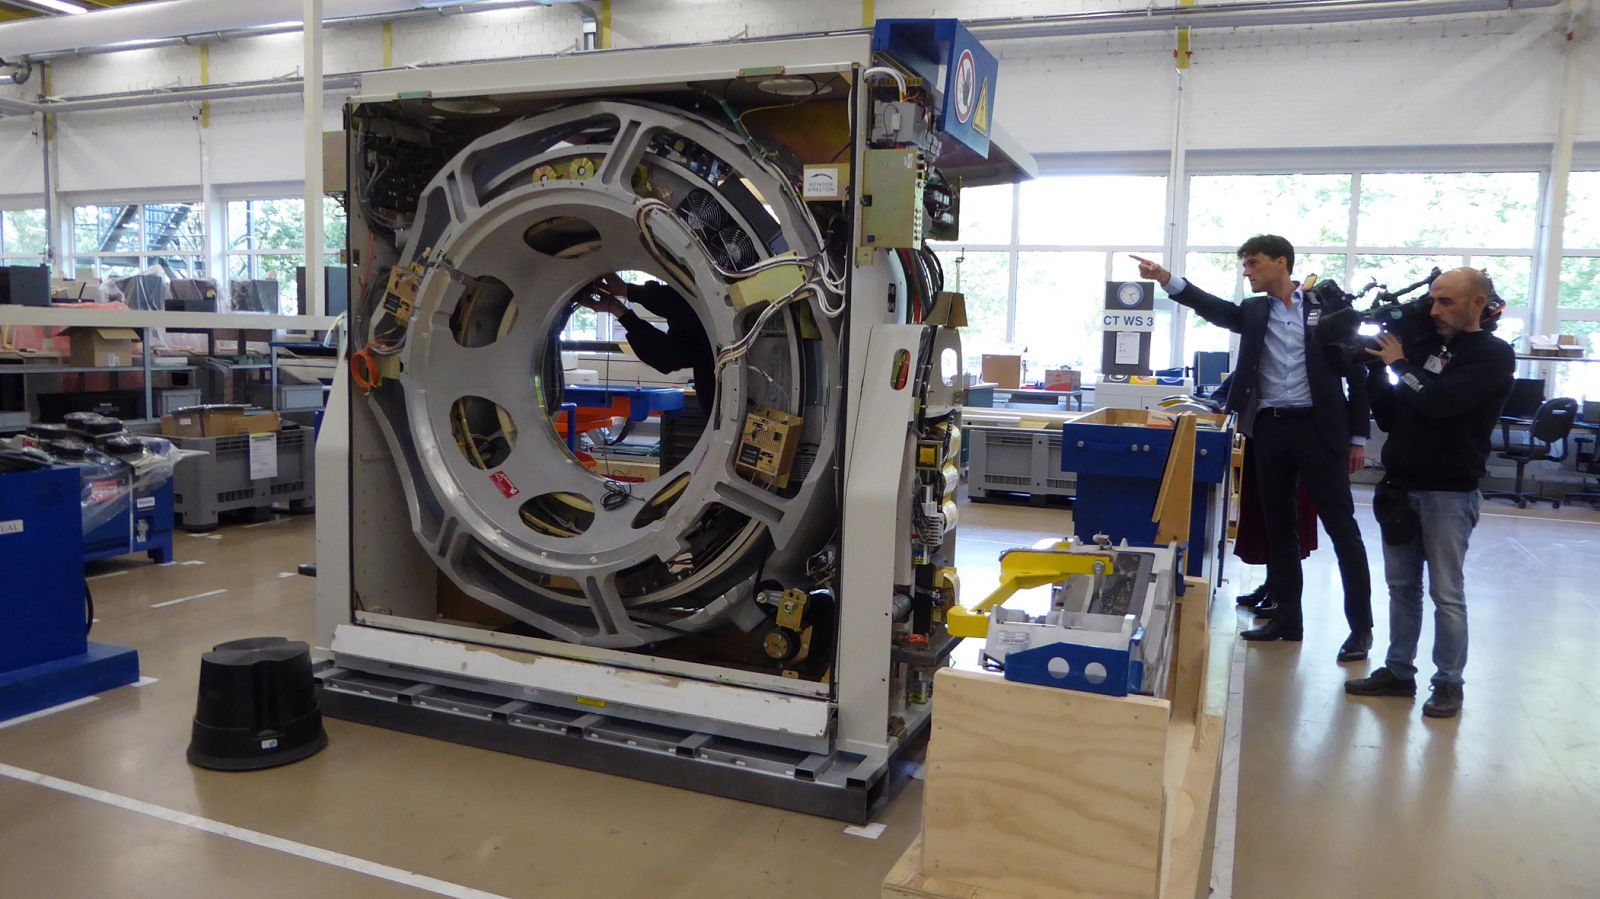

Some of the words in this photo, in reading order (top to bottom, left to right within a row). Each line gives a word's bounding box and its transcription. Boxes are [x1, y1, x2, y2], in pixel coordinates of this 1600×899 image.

[1104, 315, 1120, 326] CT
[1124, 316, 1143, 326] WS
[1147, 316, 1154, 326] 3
